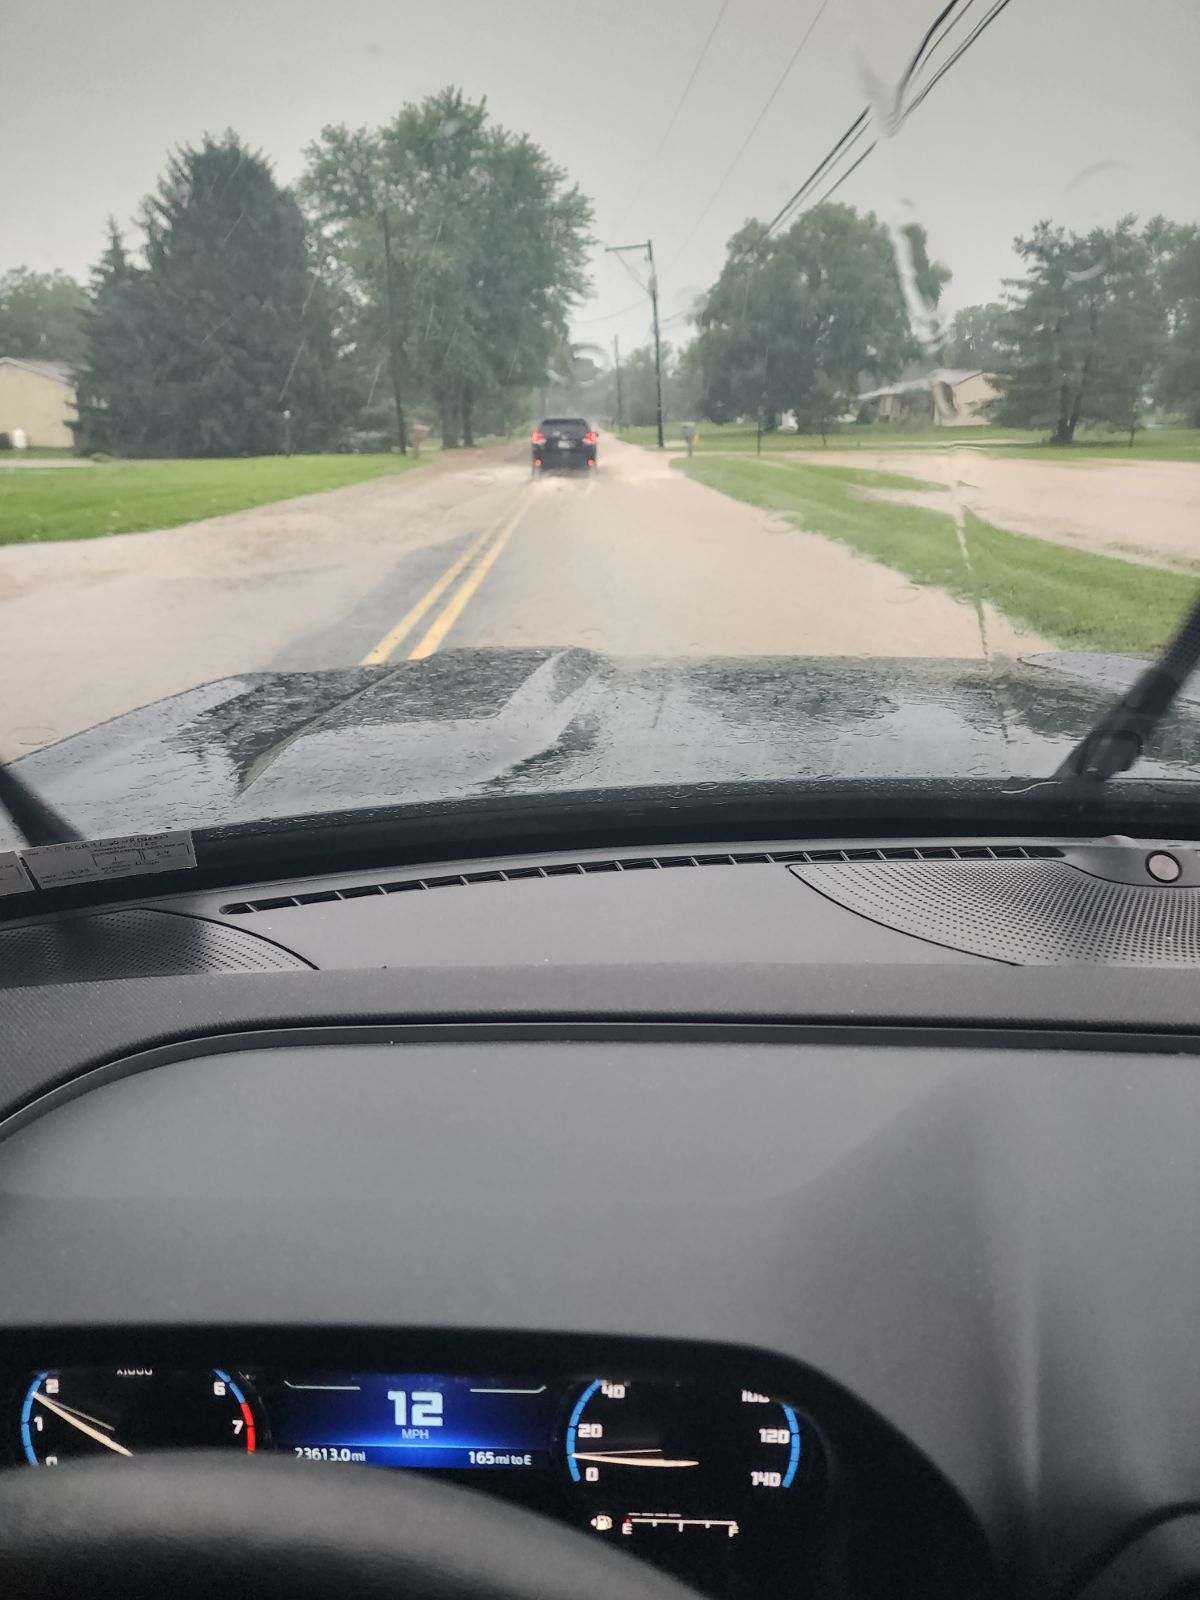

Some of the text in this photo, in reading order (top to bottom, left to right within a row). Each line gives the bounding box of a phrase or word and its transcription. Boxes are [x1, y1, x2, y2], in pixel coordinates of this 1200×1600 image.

[45, 1378, 59, 1394] 2
[213, 1381, 226, 1396] 6
[387, 1390, 444, 1427] 12
[33, 1415, 44, 1432] 1
[231, 1419, 244, 1435] 7
[578, 1423, 603, 1438] 20
[401, 1428, 429, 1440] MPH
[759, 1428, 790, 1444] 120
[585, 1466, 599, 1482] 0
[751, 1471, 781, 1487] 140
[621, 1521, 633, 1535] E
